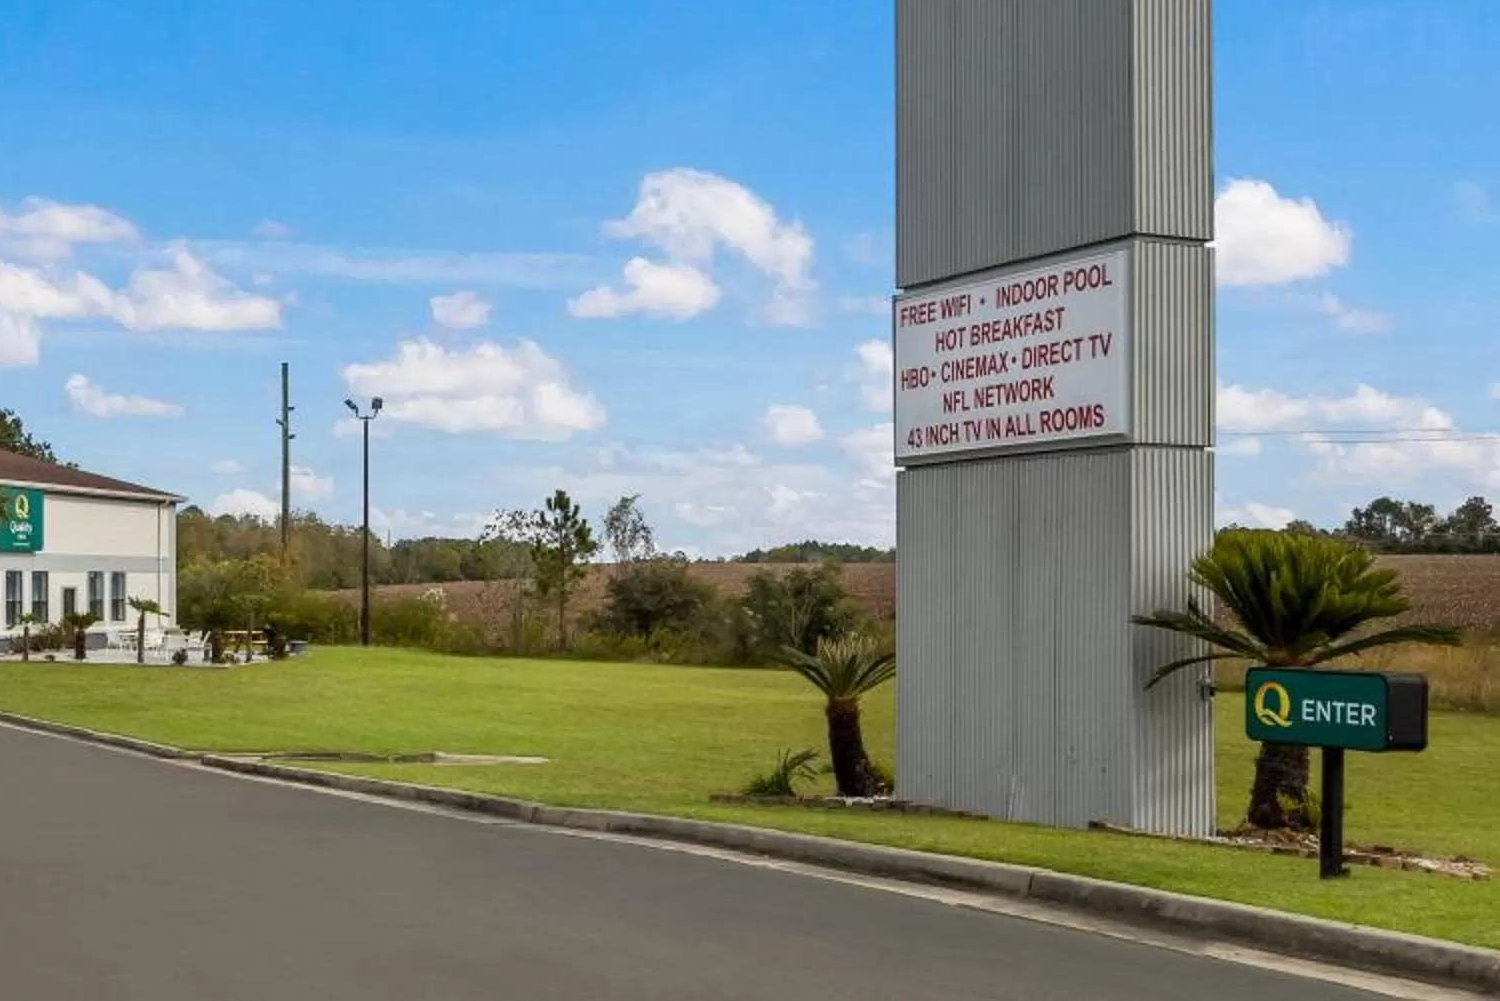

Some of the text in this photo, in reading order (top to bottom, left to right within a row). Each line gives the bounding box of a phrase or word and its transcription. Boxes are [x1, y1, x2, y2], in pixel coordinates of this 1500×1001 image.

[901, 263, 1112, 328] FREE WIFI INDOOR POOL
[935, 307, 1065, 353] HOT BREAKFAST
[941, 351, 1009, 383] CINEMAX
[1022, 338, 1083, 370] DIRECT
[1088, 332, 1112, 359] TV
[943, 375, 1055, 414] NFL NETWORK
[907, 404, 1105, 449] 43 INCH TV IN ALL ROOMS
[15, 494, 29, 519] Q
[1255, 681, 1377, 727] Q ENTER
